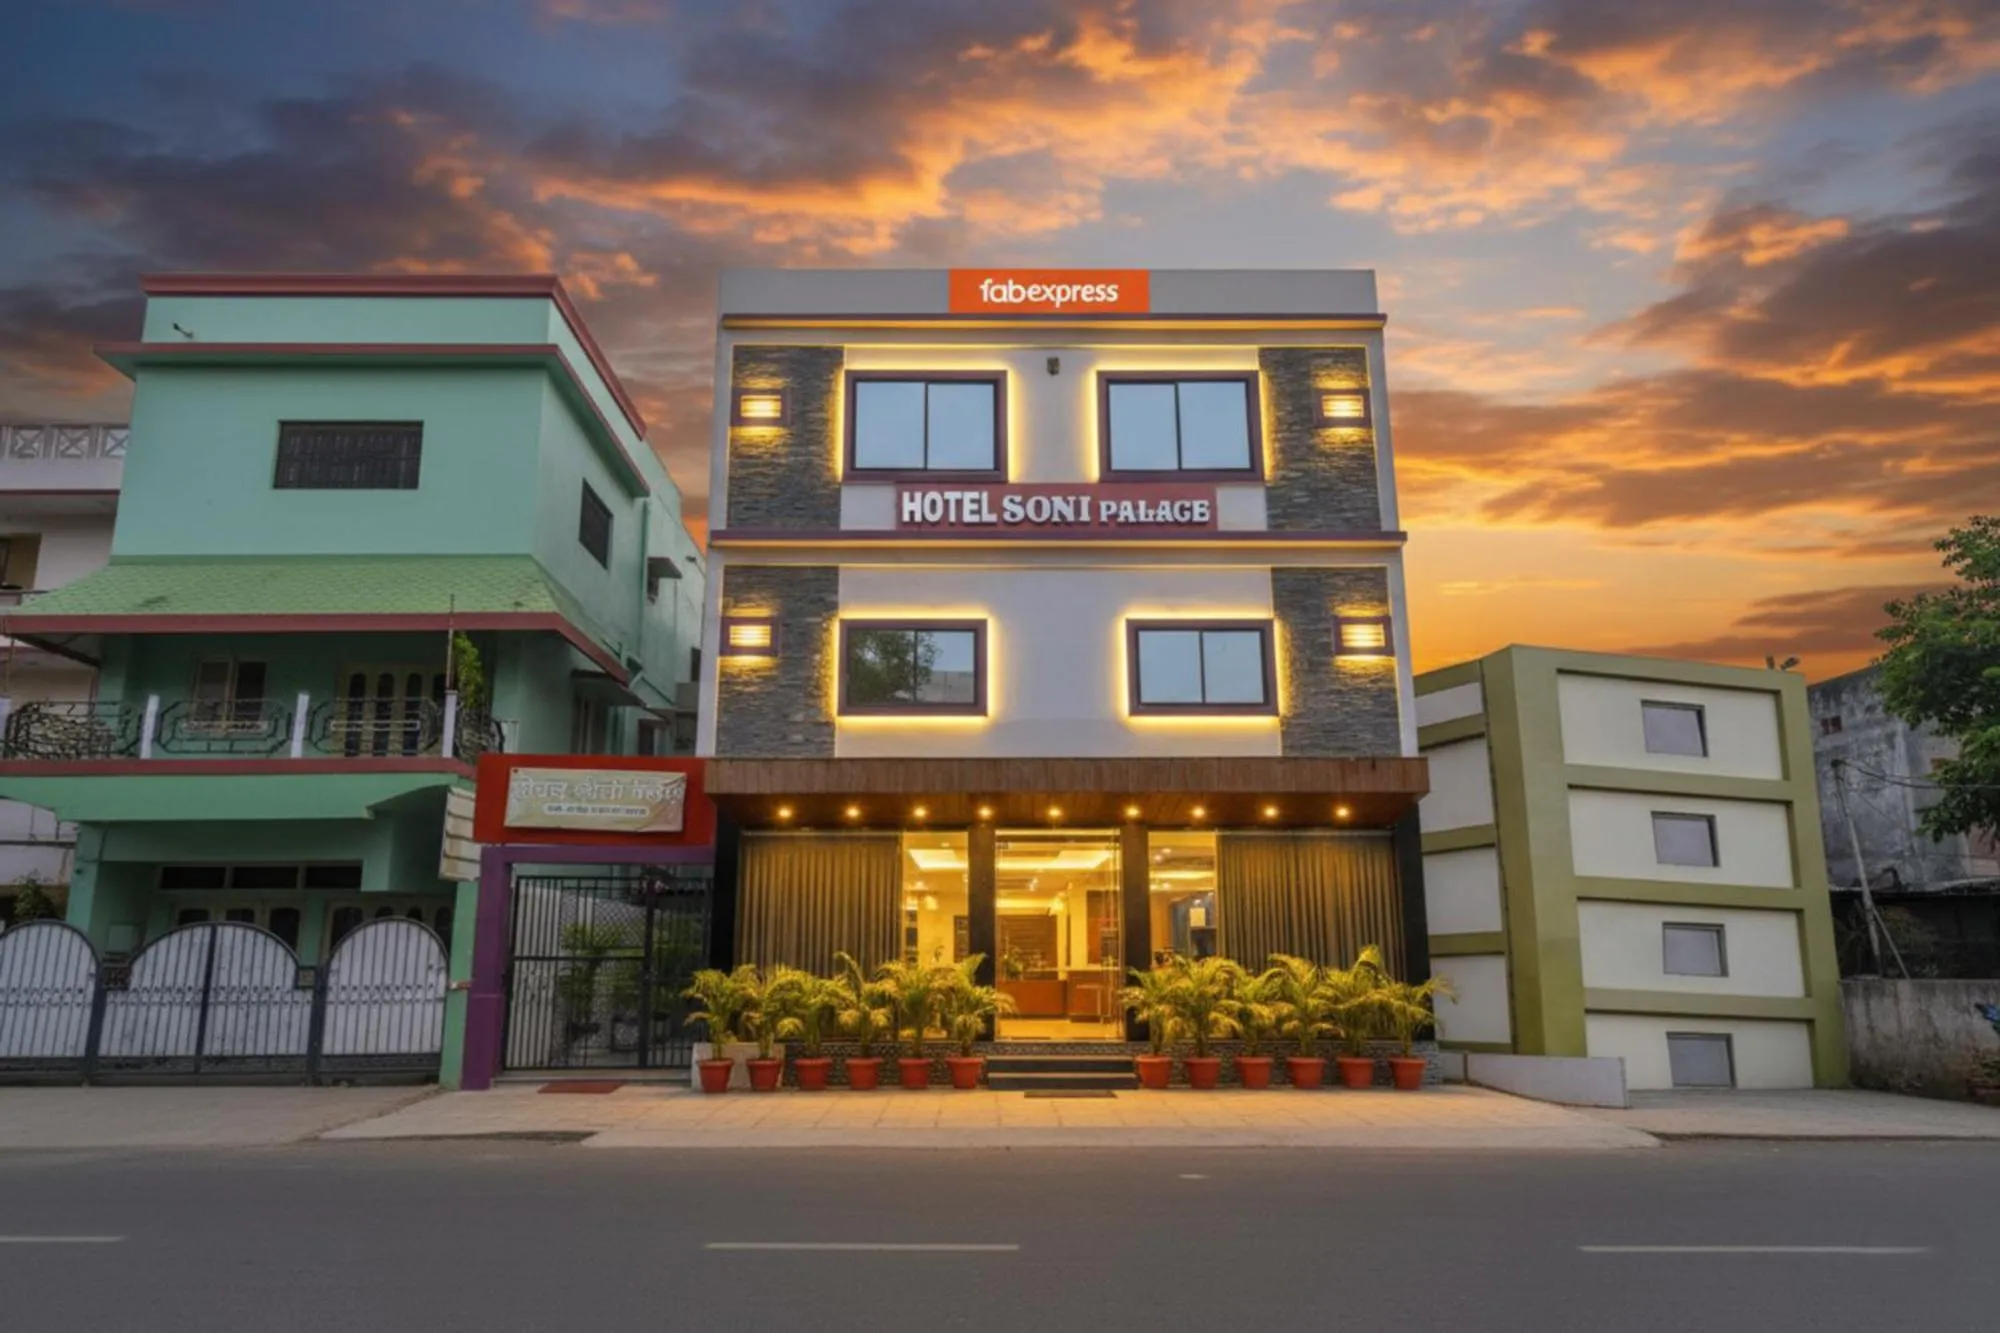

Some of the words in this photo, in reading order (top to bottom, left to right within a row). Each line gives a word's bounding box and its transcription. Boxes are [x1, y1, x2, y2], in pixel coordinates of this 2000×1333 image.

[979, 278, 1119, 308] fabexpress
[902, 491, 997, 523] HOTEL
[1002, 495, 1091, 523] SONI
[1099, 500, 1209, 523] PALACE
